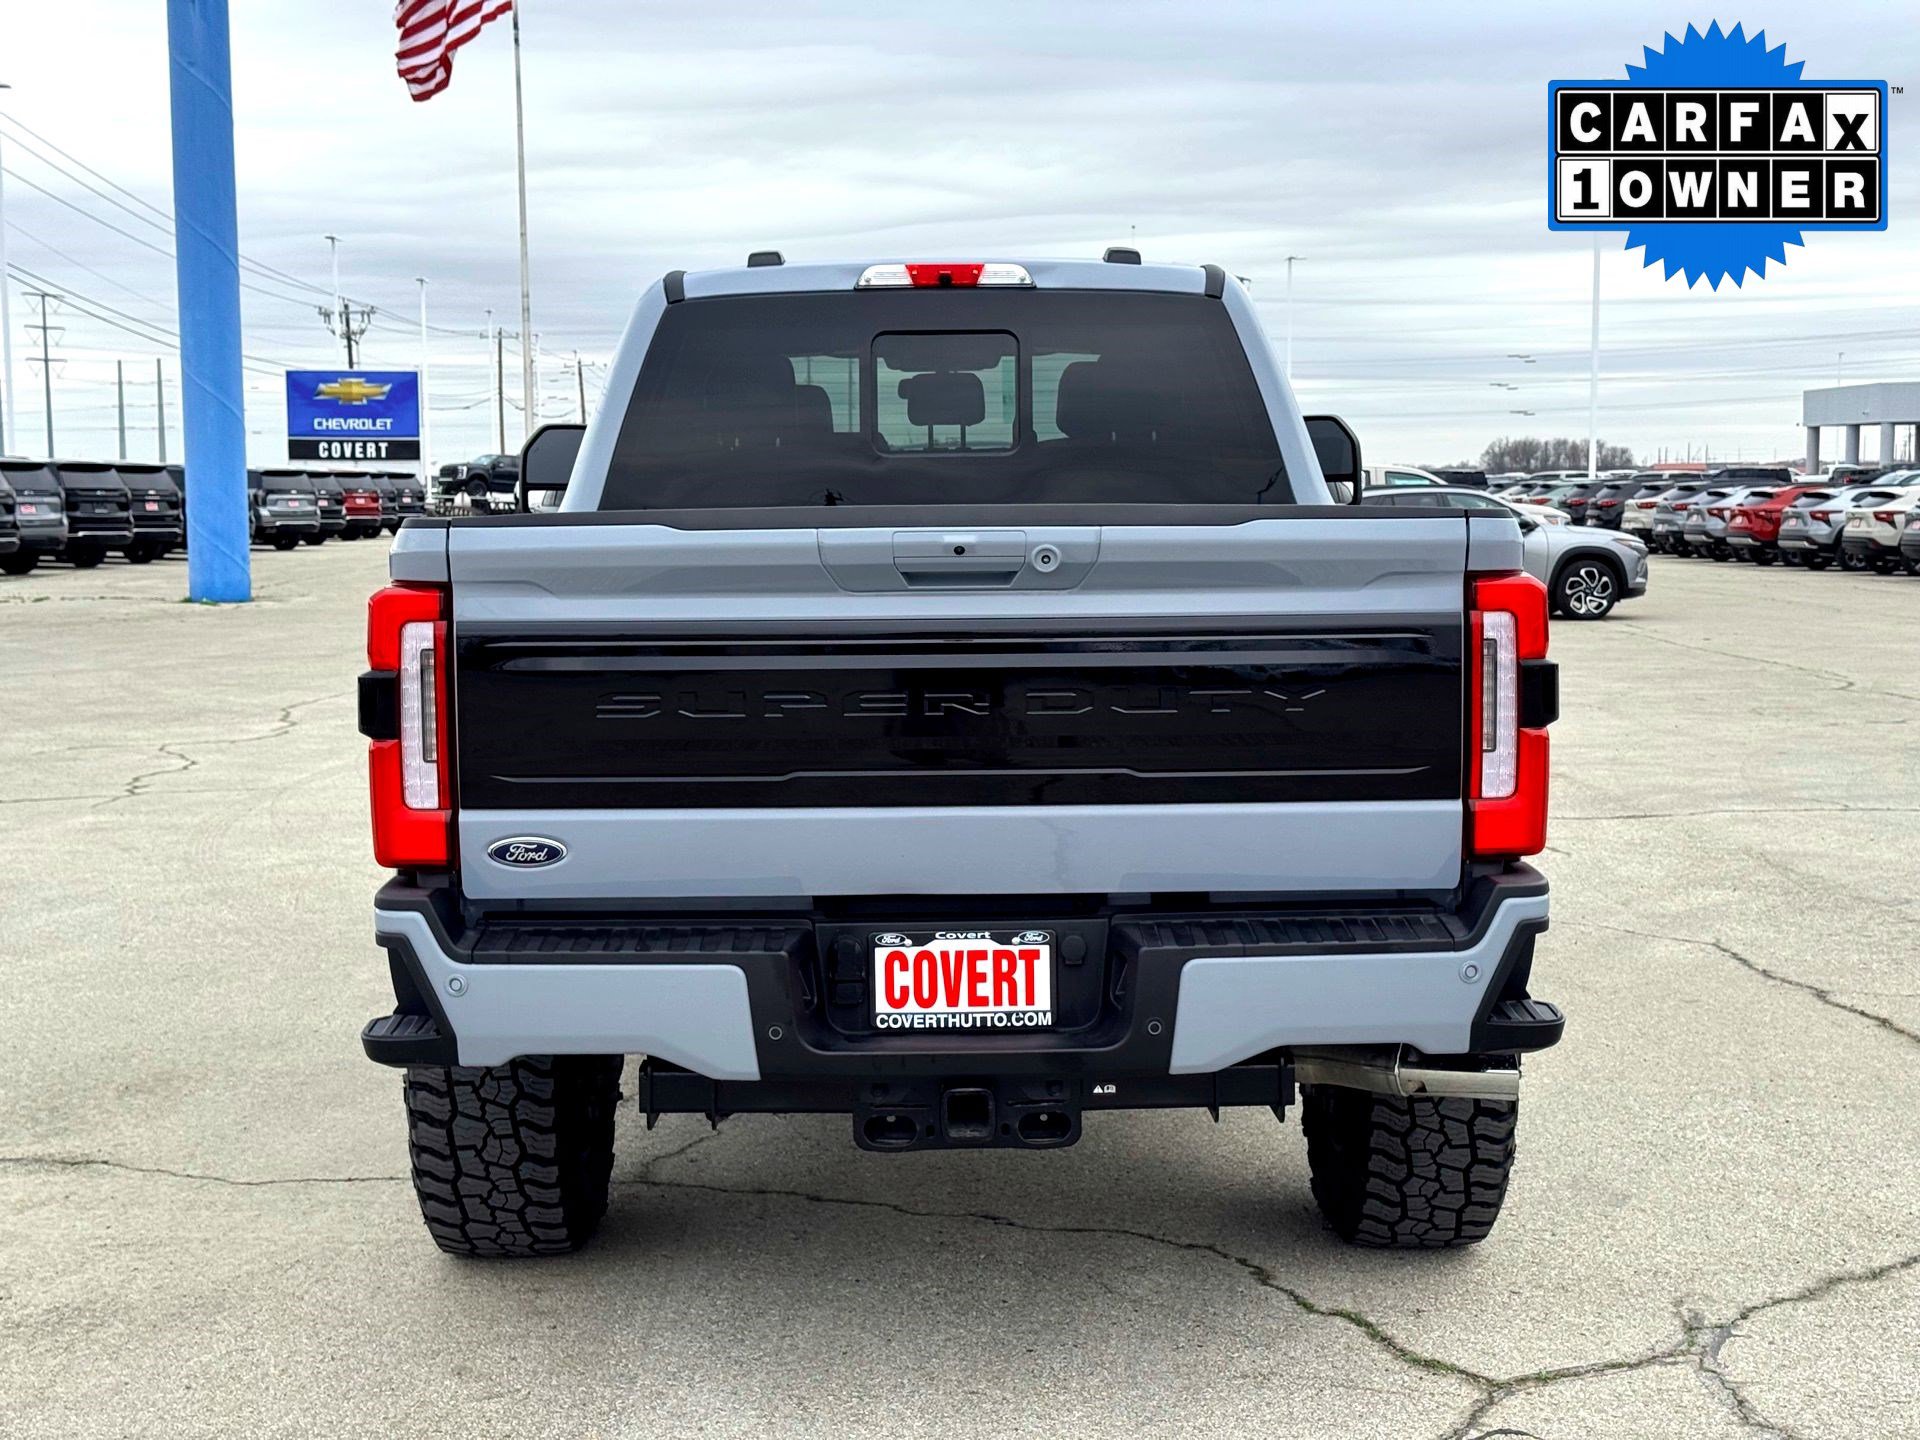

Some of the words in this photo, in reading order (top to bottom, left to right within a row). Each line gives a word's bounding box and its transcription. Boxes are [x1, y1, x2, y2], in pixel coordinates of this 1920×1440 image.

[313, 417, 393, 431] CHEVROLET
[318, 441, 389, 459] COVERT
[595, 691, 991, 718] SUPER
[1025, 687, 1327, 716] DUTY
[505, 843, 549, 861] Ford
[880, 934, 901, 944] Ford
[934, 931, 992, 940] Covert
[1024, 932, 1044, 942] Ford
[884, 949, 1041, 1010] COVERT
[875, 1011, 1053, 1029] COVERTHUTTO.COM
